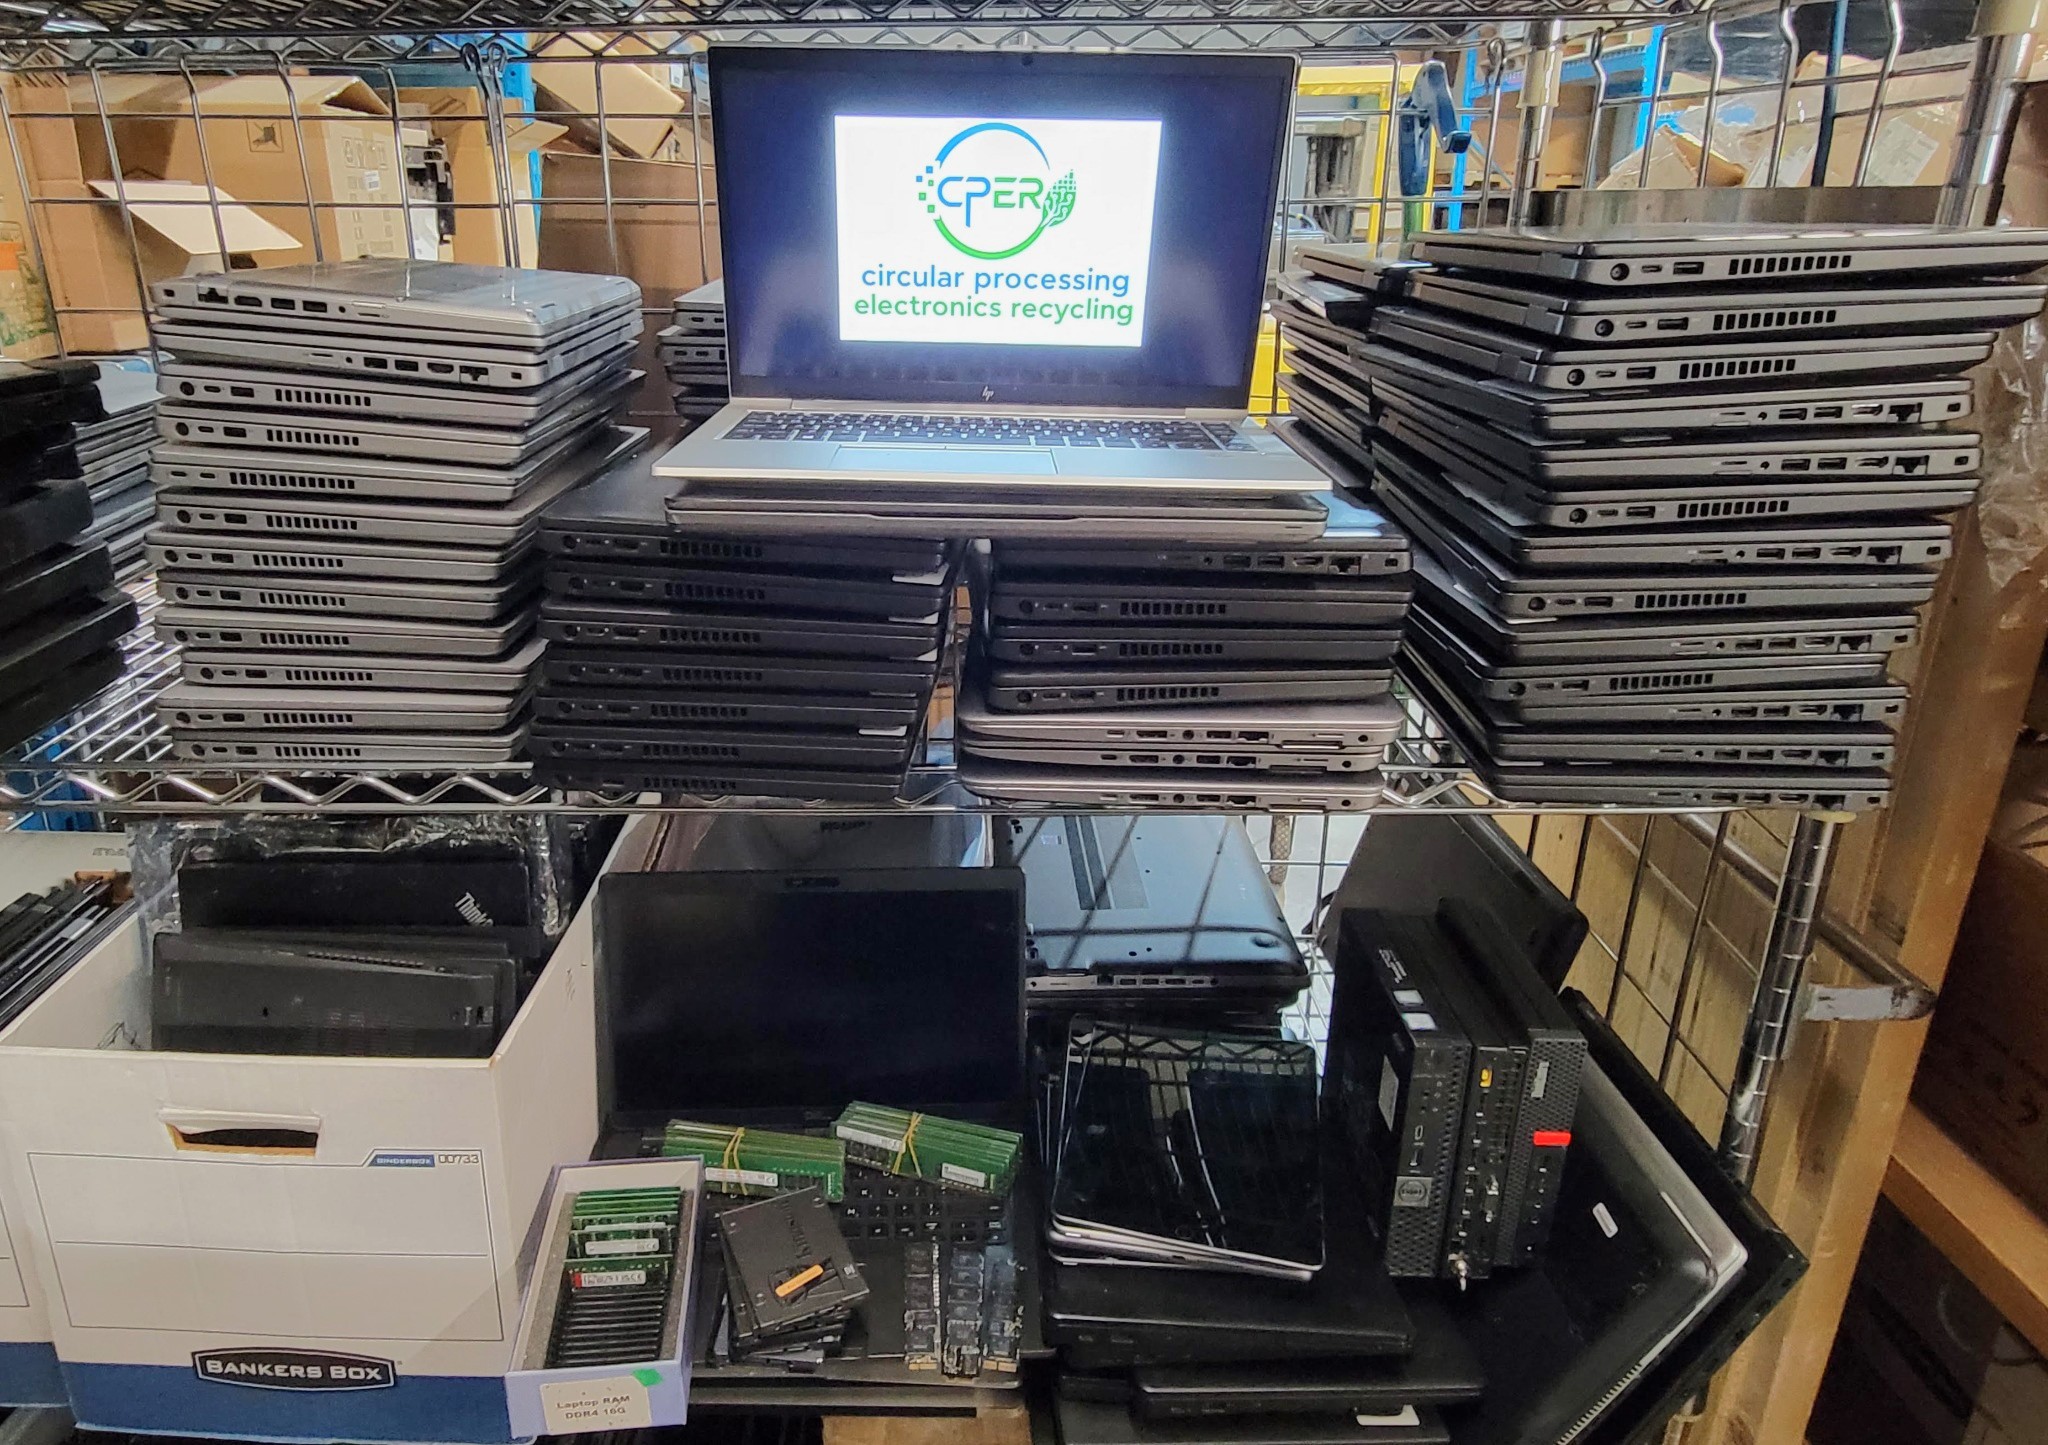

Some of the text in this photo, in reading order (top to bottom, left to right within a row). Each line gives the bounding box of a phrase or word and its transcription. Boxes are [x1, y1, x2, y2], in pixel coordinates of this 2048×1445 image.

[937, 176, 1044, 228] CPER
[861, 263, 1130, 297] circular processing
[854, 293, 1134, 326] electronics recycling
[438, 1154, 480, 1164] 00733
[205, 1359, 383, 1381] BANKERS BOX
[557, 1395, 630, 1409] Laptop RAM
[566, 1407, 625, 1419] DDR4 16G
